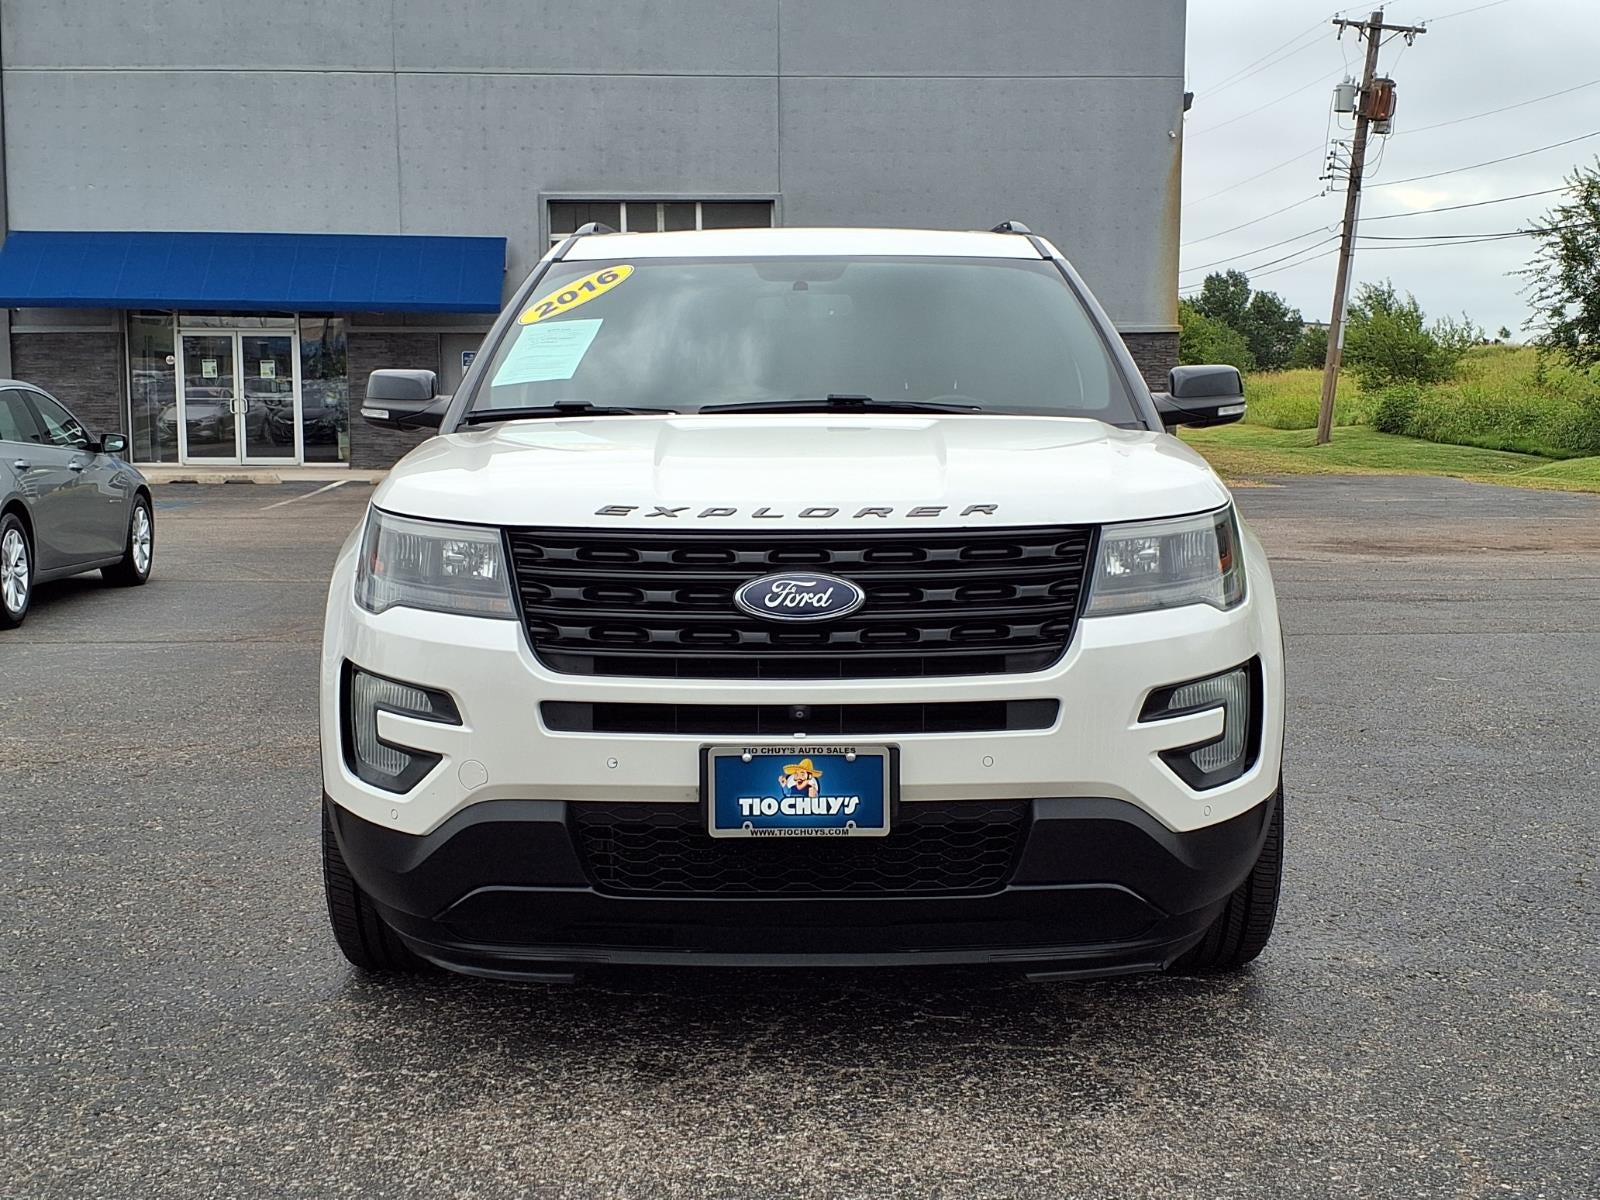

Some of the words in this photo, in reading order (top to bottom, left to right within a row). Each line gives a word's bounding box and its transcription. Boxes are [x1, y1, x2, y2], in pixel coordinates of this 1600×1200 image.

[534, 271, 619, 318] 2016
[594, 503, 999, 519] EXPLORER
[764, 580, 833, 608] Ford
[750, 828, 849, 837] WWW.TIOCHUYS.COM
